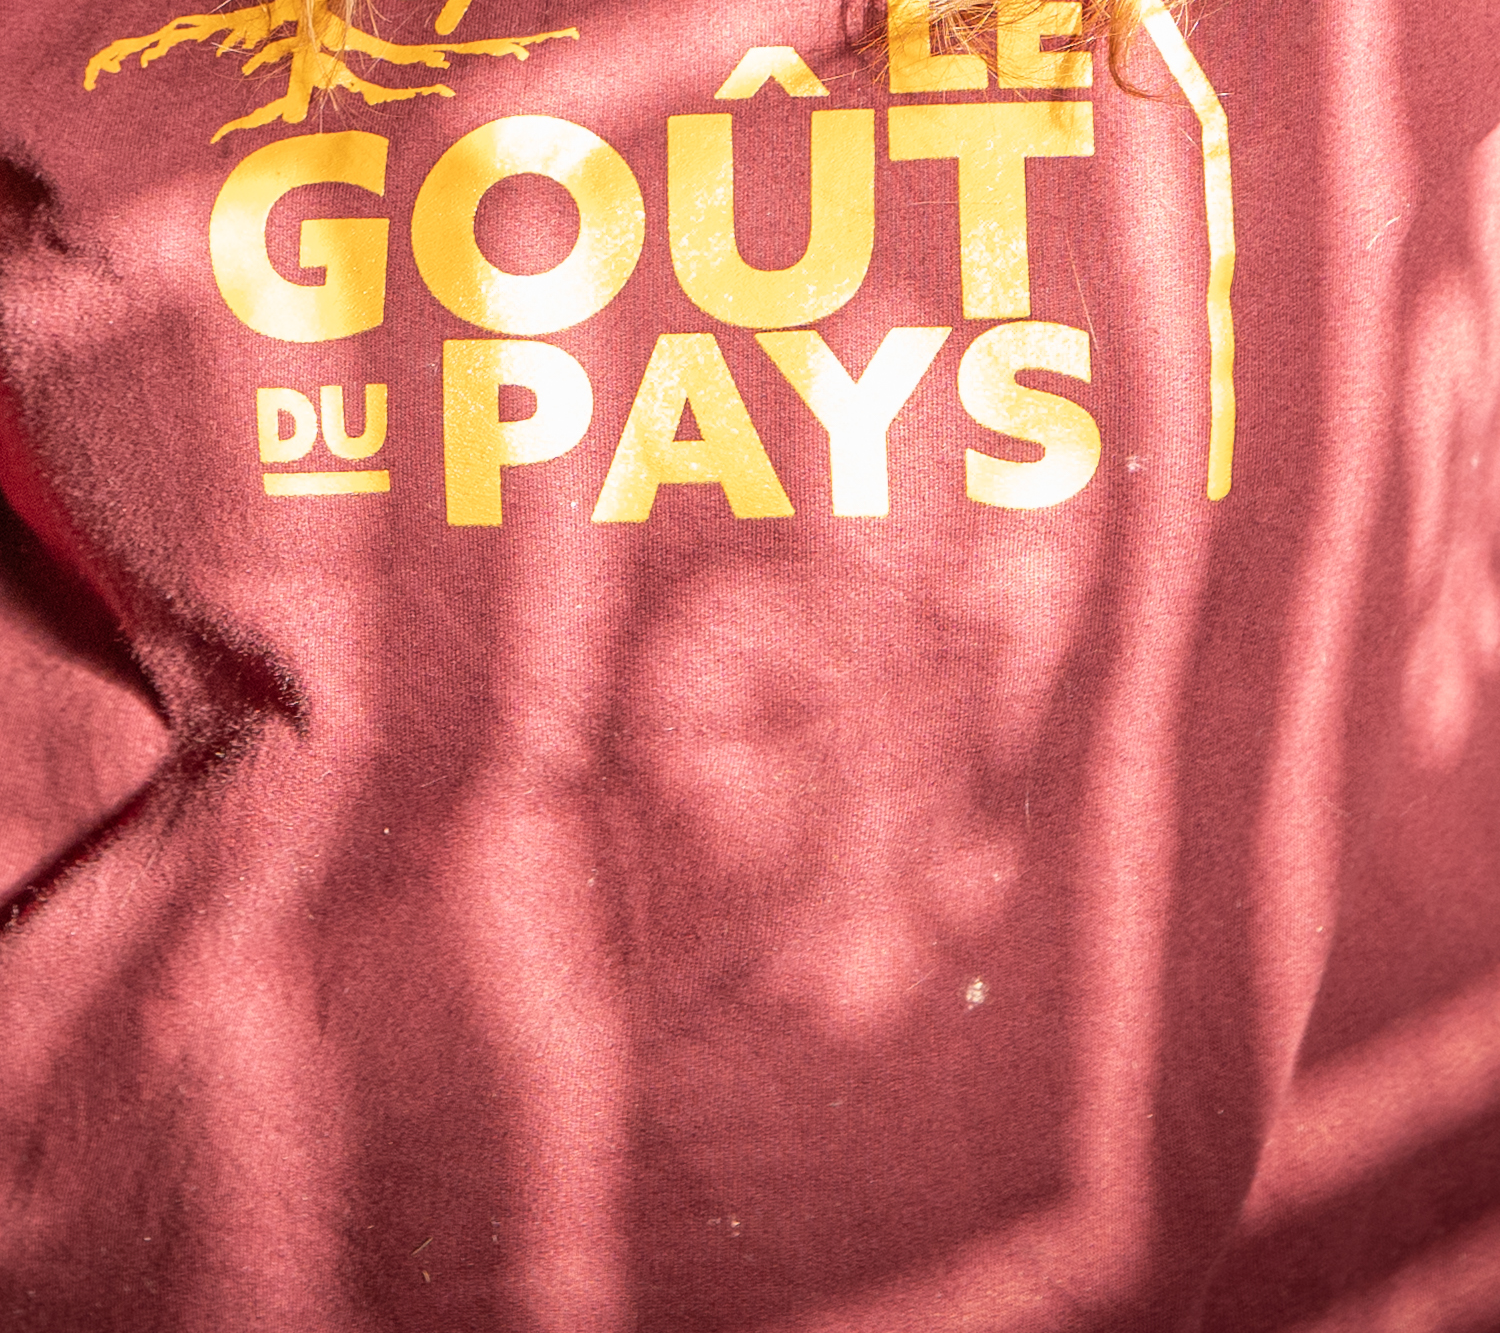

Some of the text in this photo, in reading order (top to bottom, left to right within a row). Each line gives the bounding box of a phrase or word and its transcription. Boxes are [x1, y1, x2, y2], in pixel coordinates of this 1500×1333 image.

[210, 44, 1095, 343] GOÛT
[256, 319, 1103, 527] DU PAYS
